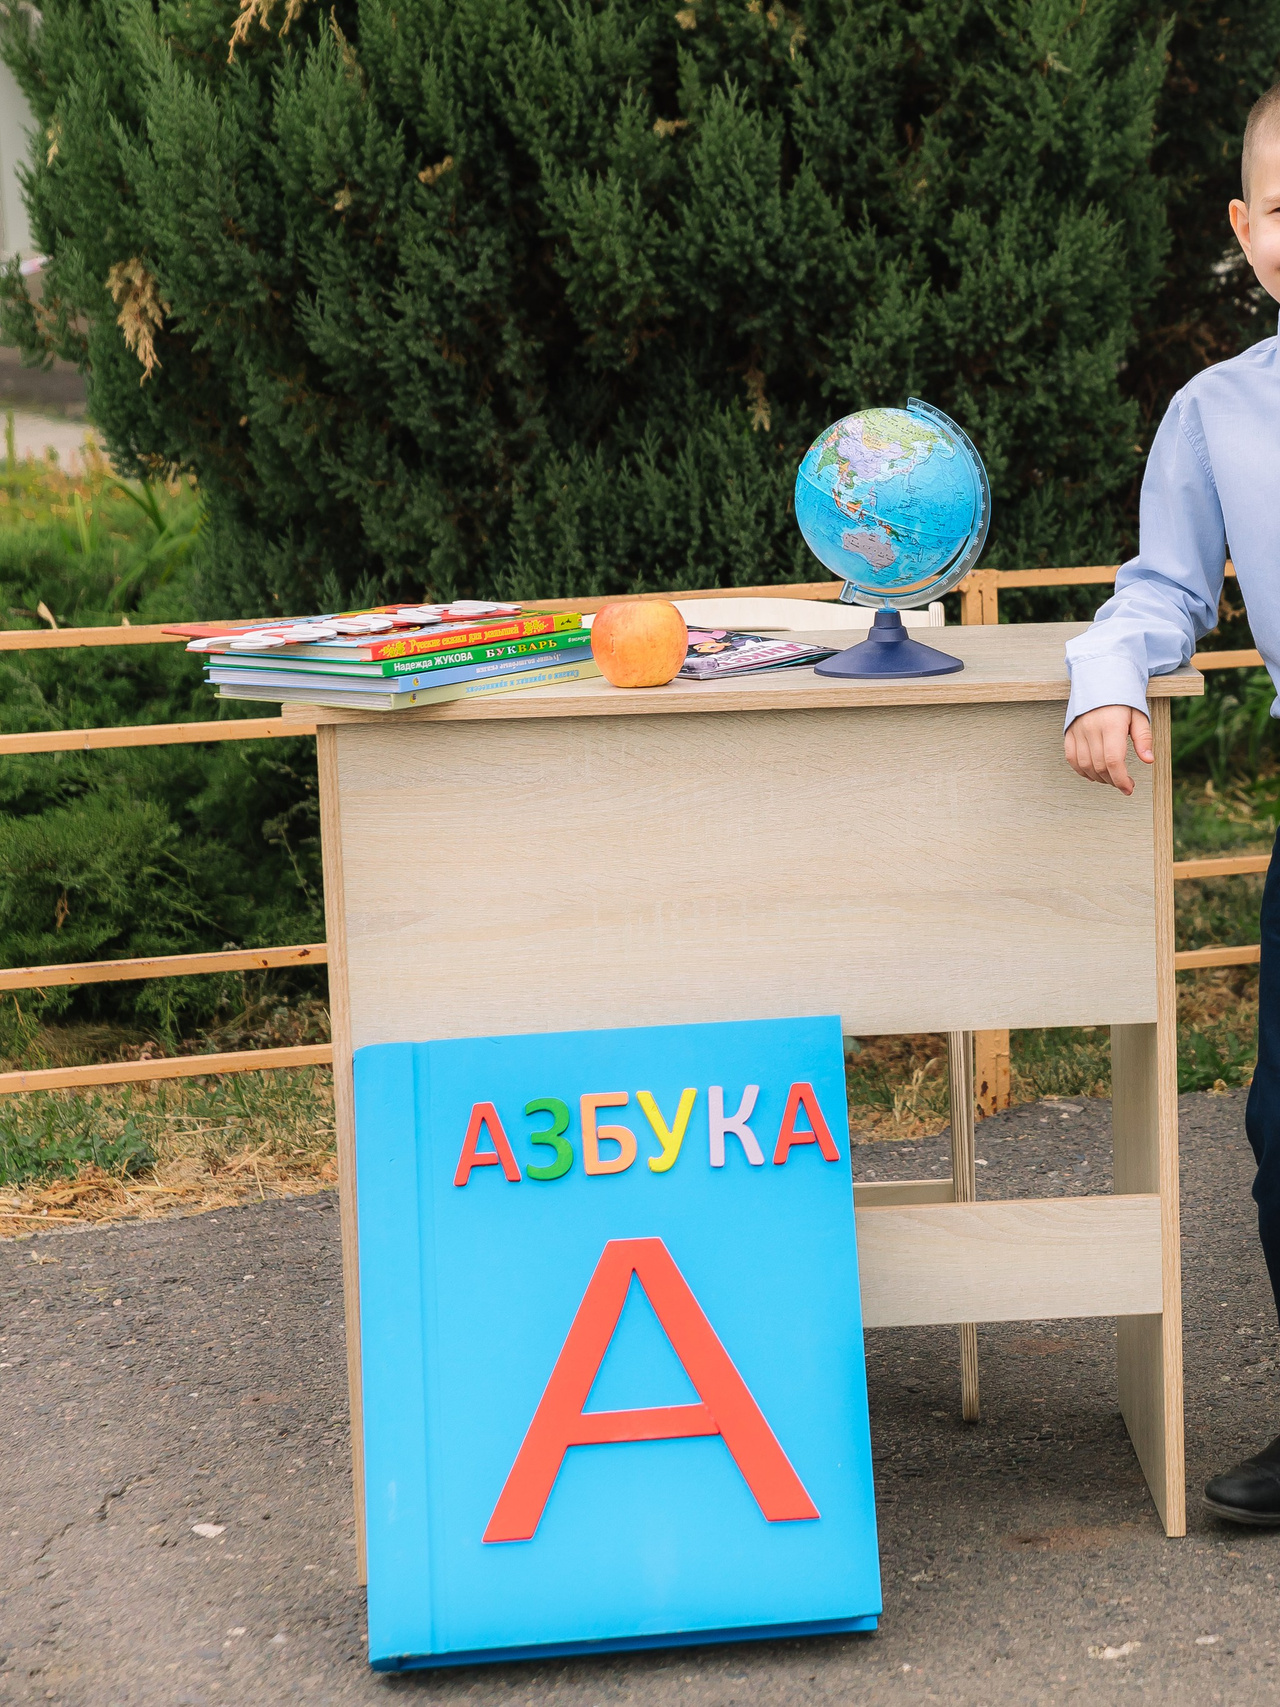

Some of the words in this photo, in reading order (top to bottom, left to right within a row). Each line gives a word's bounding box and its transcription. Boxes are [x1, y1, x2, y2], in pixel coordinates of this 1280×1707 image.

[409, 639, 441, 653] Русские
[441, 634, 467, 646] сказки
[468, 632, 482, 643] для
[484, 624, 519, 640] малышей
[393, 659, 433, 674] Надежда
[434, 652, 473, 666] ЖУКОВА
[485, 640, 557, 658] БУКВАРЬ
[466, 680, 508, 693] принцессах
[516, 673, 546, 686] принцах
[554, 669, 579, 679] Сказки
[453, 1082, 841, 1187] АЗБУКА
[481, 1237, 821, 1543] А
